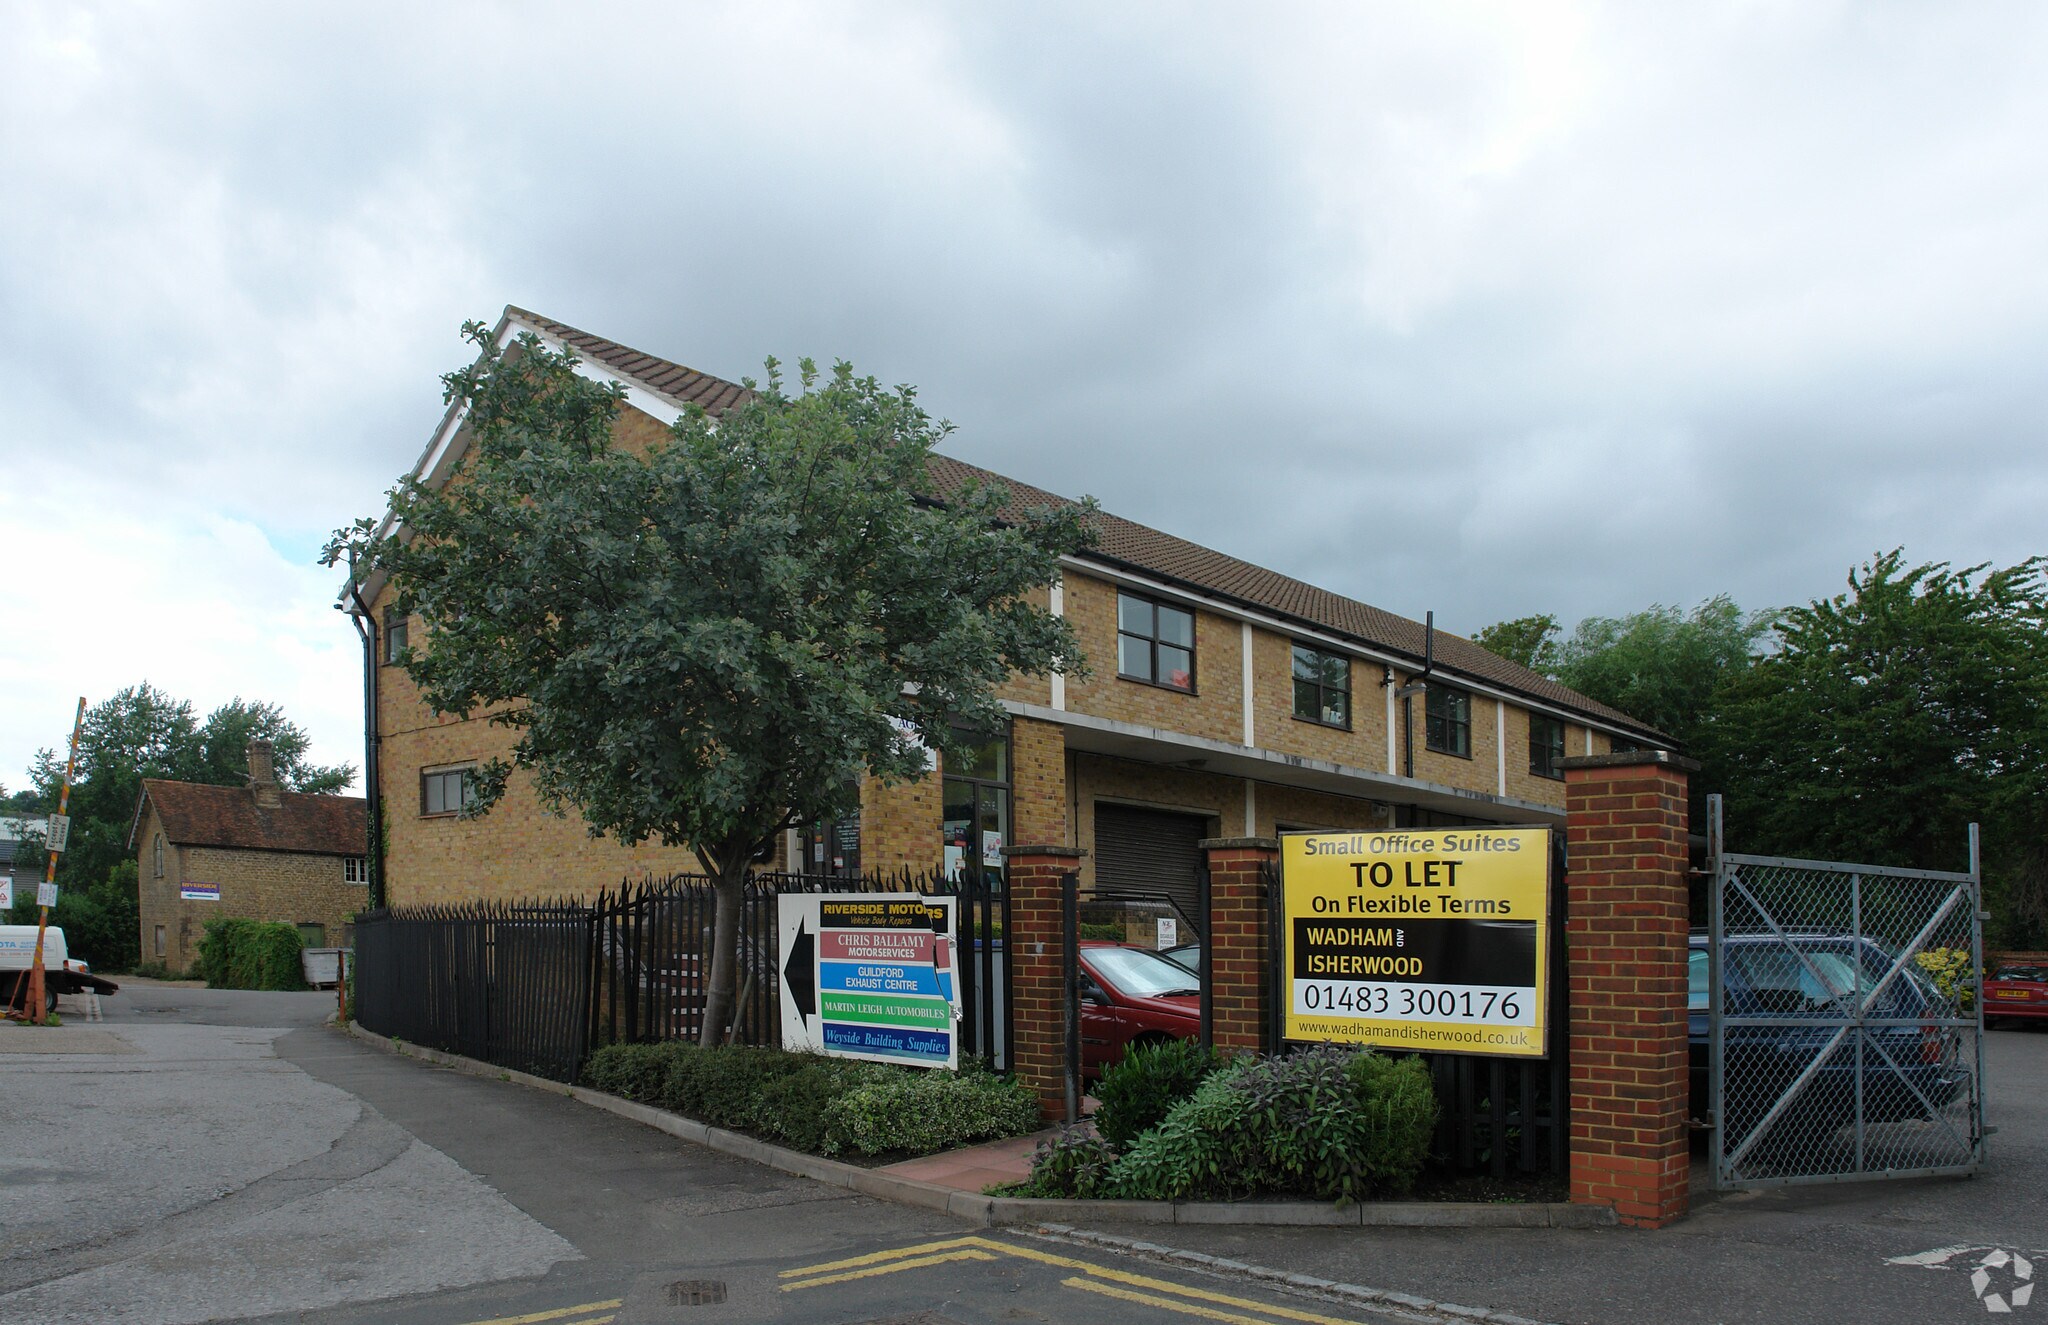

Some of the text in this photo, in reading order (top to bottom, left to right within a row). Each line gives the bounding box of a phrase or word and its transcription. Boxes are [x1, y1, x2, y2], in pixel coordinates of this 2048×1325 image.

[49, 827, 58, 848] Except
[58, 823, 66, 845] access
[1304, 833, 1521, 856] Small Office Suites
[1349, 860, 1463, 888] TO LET
[823, 903, 944, 919] RIVERSIDE MOTORS
[1312, 894, 1511, 914] On Flexible Terms
[850, 915, 913, 927] Vehicle Body Repairs
[838, 934, 926, 948] CHRIS BALLAMY
[1307, 927, 1393, 947] WADHAM
[1396, 928, 1405, 947] AND
[848, 947, 915, 958] MOTORSERVICES
[858, 966, 904, 978] GUILDFORD
[1308, 955, 1423, 976] ISHERWOOD
[845, 977, 918, 991] EXHAUST CENTRE
[825, 1001, 945, 1019] MARTIN LEIGH AUTOMOBILES
[1304, 984, 1520, 1019] 01483 300176
[826, 1029, 946, 1053] Weyside Building Supplies
[1298, 1021, 1528, 1046] www.wadhamandisherwood.co.uk
